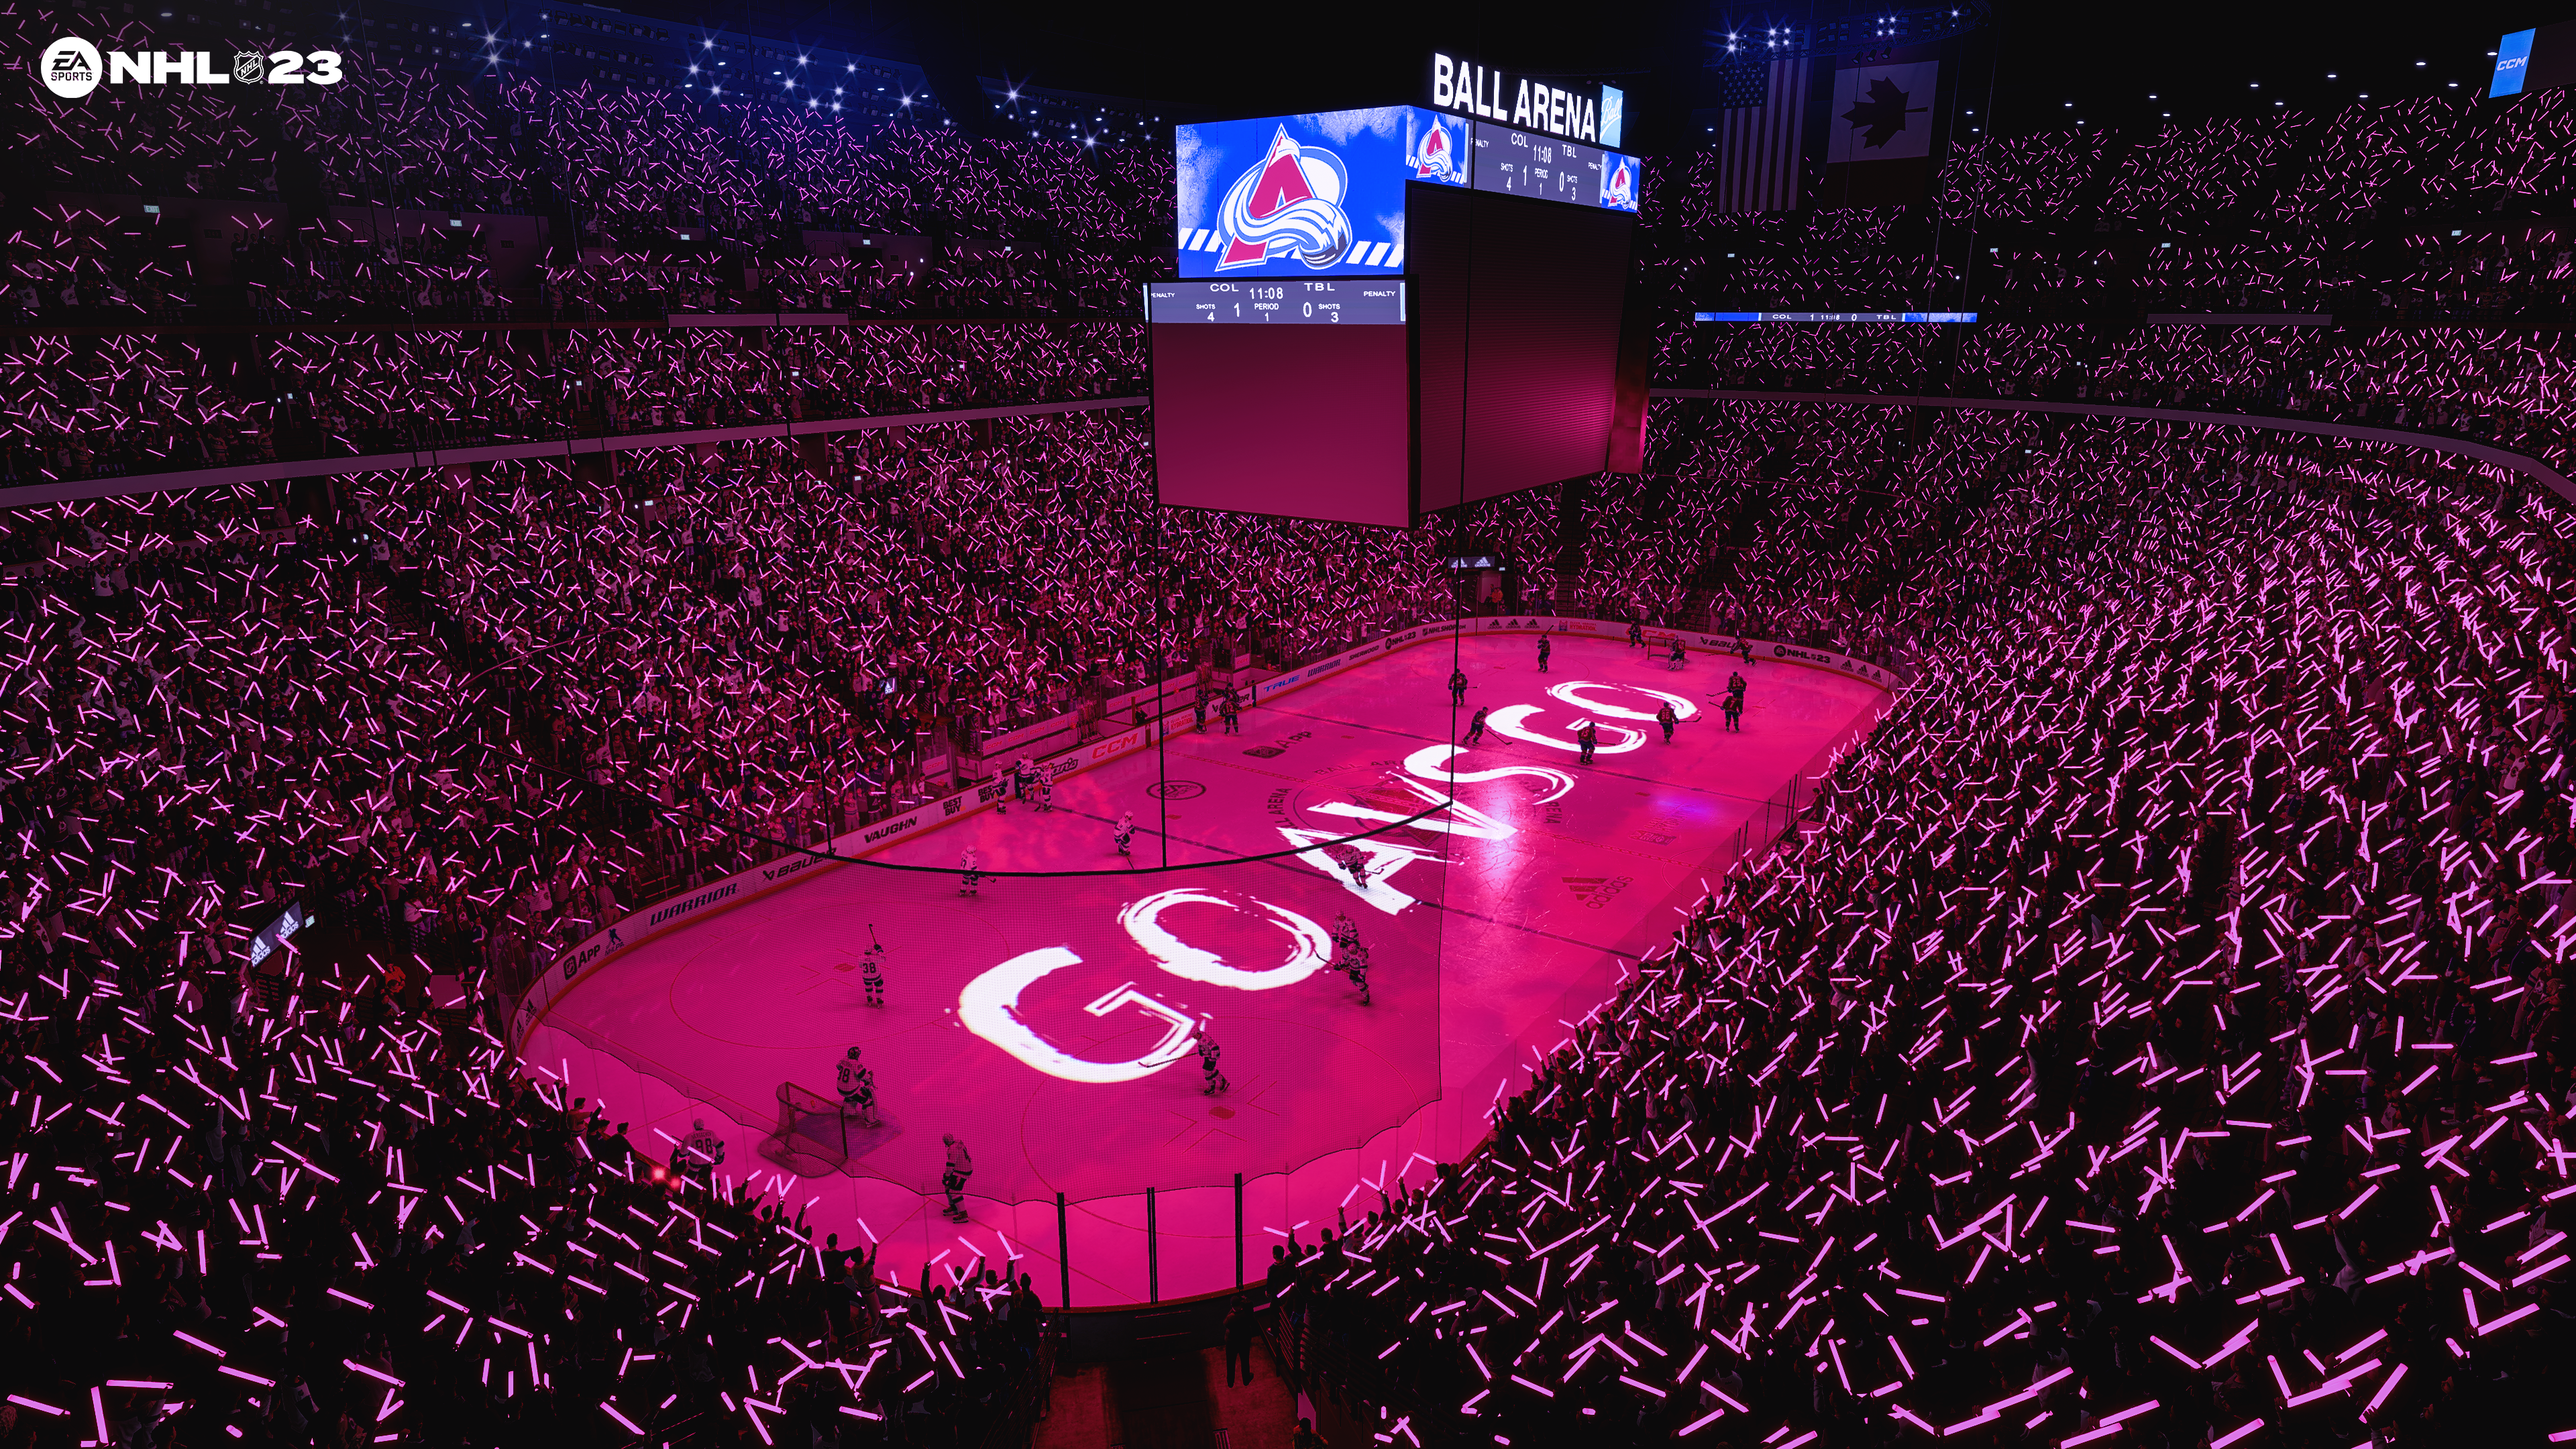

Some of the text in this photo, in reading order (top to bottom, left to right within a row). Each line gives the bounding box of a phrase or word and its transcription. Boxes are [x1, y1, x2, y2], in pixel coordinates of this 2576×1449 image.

[2497, 56, 2528, 71] CCM
[1434, 52, 1597, 143] BALL ARENA
[1602, 95, 1623, 127] Ball
[1470, 138, 1489, 148] PNALTY
[1511, 132, 1529, 148] COL
[1534, 144, 1552, 164] 11:08
[1562, 144, 1577, 158] TBL
[1500, 162, 1514, 172] SHOTS
[1534, 168, 1549, 179] PERIOD
[1523, 165, 1527, 186] 1
[1559, 171, 1565, 193] 0
[1506, 176, 1512, 191] 4
[1539, 182, 1542, 195] 1
[1571, 186, 1576, 201] 3
[1210, 283, 1239, 292] COL
[1249, 286, 1283, 300] 11:08
[1303, 282, 1336, 292] TBL
[1234, 303, 1240, 317] 1
[1254, 303, 1279, 311] PERIOD
[1303, 301, 1312, 318] 0
[1207, 311, 1216, 323] 4
[1265, 312, 1269, 322] 1
[1330, 311, 1339, 323] 3
[1811, 313, 1814, 321] 1
[1851, 313, 1858, 321] 0
[1428, 624, 1466, 634] NHLSHOPOM
[1348, 645, 1380, 661] SHERWOOD
[1787, 649, 1811, 660] NHL
[1816, 653, 1831, 664] 23
[1307, 658, 1341, 678] WARRIOR
[1264, 674, 1300, 692] TRUE
[1030, 726, 1045, 735] CCM
[1051, 719, 1066, 728] CCM
[1008, 733, 1024, 742] CCM
[985, 740, 1003, 750] CCM
[1093, 733, 1138, 759] CCM
[925, 760, 944, 770] CCM
[943, 796, 962, 810] BEST
[1268, 787, 1293, 816] ARENA
[945, 805, 962, 817] BUY
[1543, 801, 1563, 824] RENA
[863, 816, 918, 844] VAUGHN
[956, 679, 1699, 1085] GO AVS GO
[1585, 875, 1635, 910] adidas
[649, 883, 737, 926] WARRIOR
[250, 945, 271, 968] adidas
[863, 962, 876, 973] 38
[696, 1138, 712, 1155] 98
